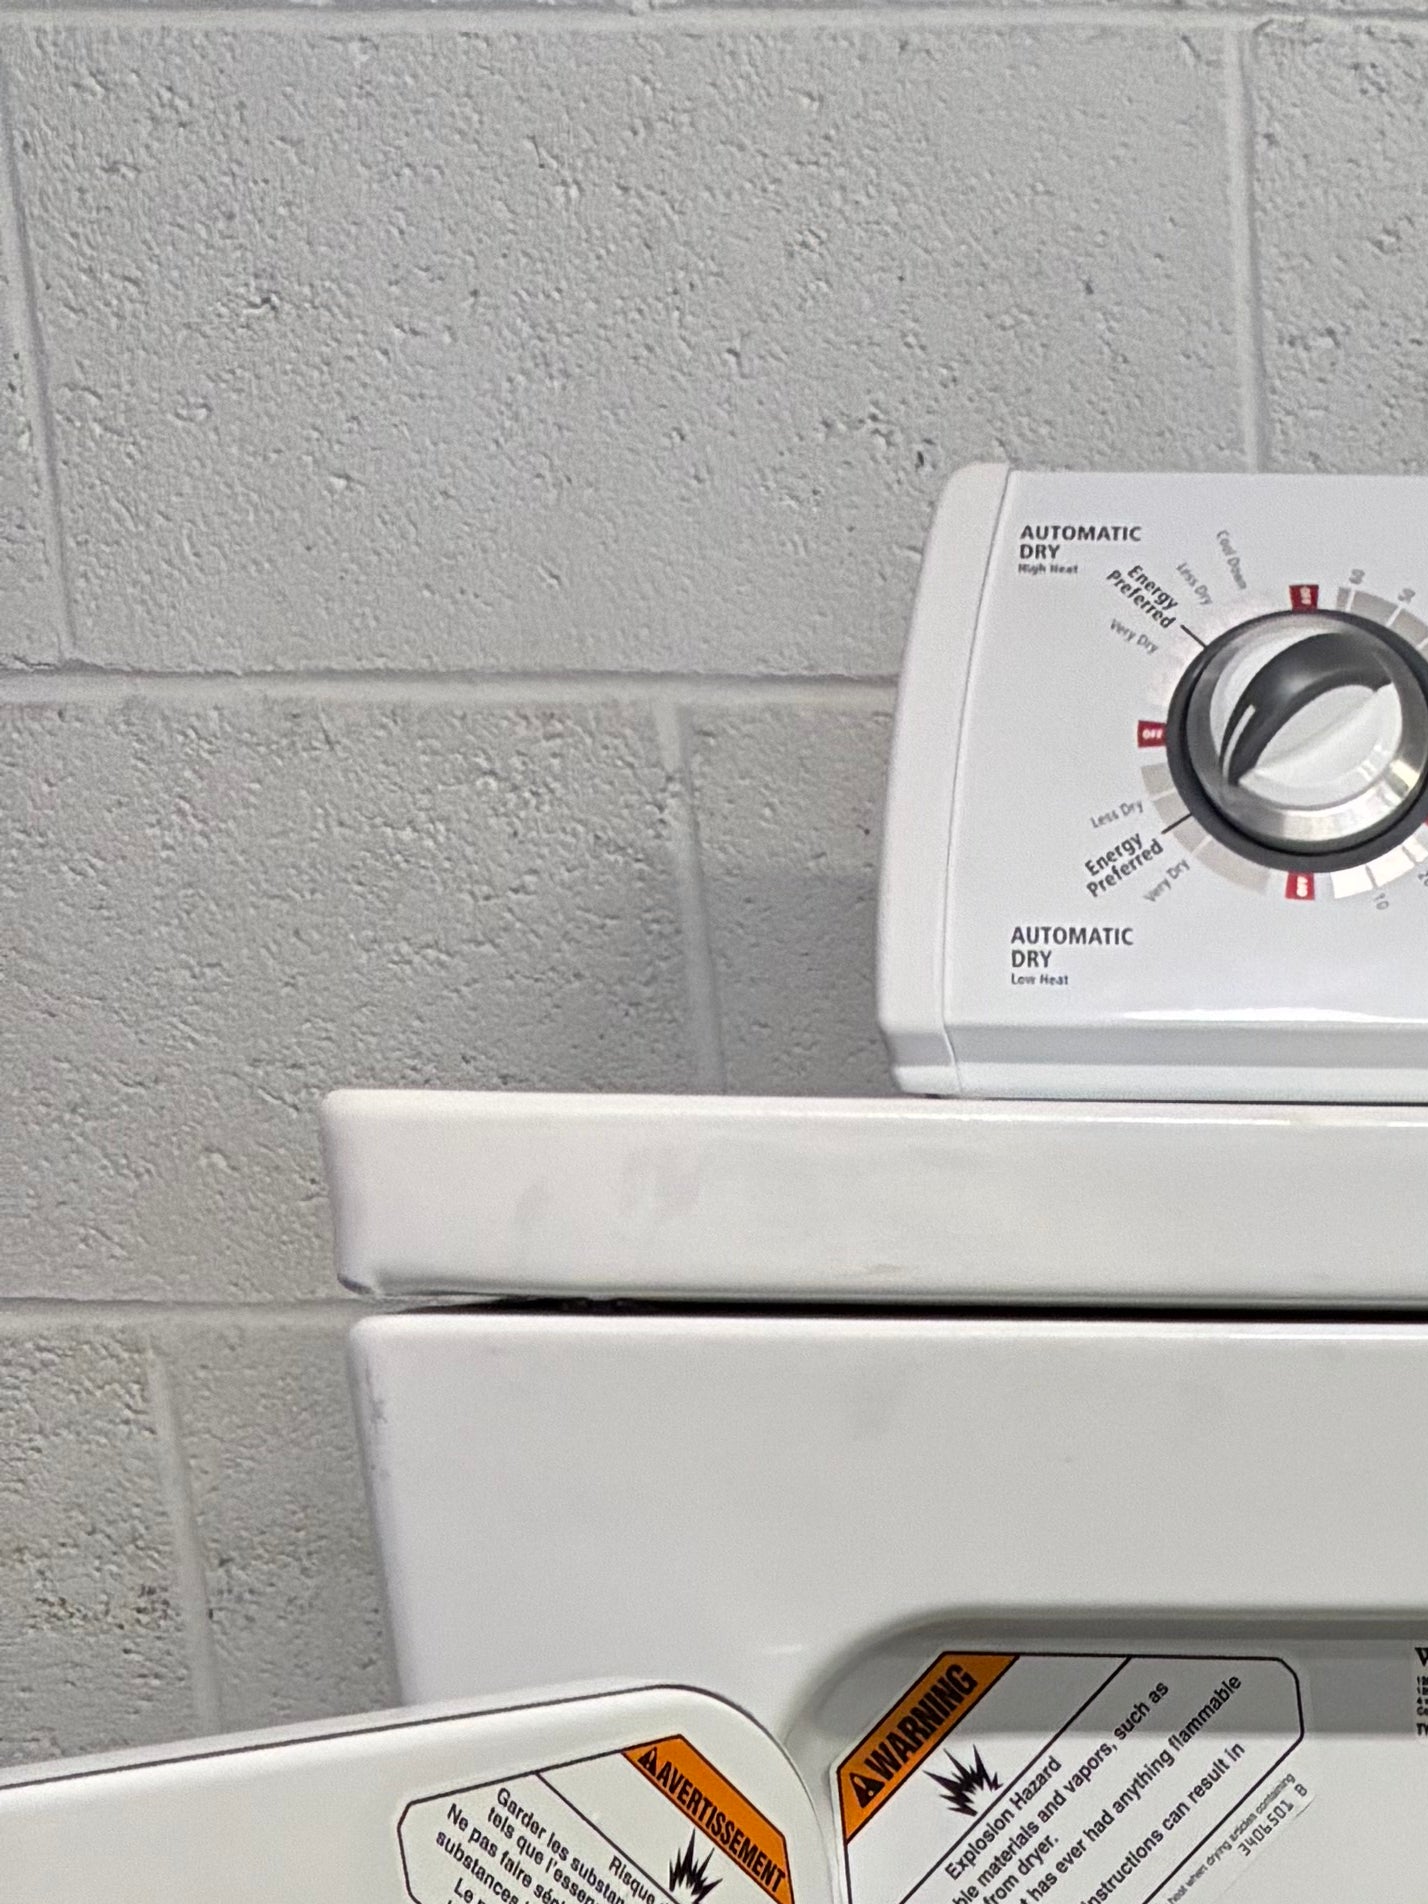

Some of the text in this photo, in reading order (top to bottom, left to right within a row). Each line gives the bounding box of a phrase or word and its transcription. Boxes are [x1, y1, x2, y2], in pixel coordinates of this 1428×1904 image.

[1019, 543, 1061, 560] DRY
[1020, 525, 1142, 542] AUTOMATIC
[1018, 564, 1078, 576] High Heat
[1127, 564, 1178, 610] Energy
[1175, 562, 1213, 606] Less Dry
[1106, 569, 1177, 629] Preferred
[1110, 618, 1159, 655] Very Dry
[1142, 728, 1163, 740] OFF
[1090, 799, 1145, 829] Less Dry
[1084, 832, 1143, 877] Energy
[1086, 838, 1164, 898] Preferred
[1143, 857, 1191, 902] Very Dry
[1374, 893, 1390, 911] 10
[1010, 926, 1134, 946] AUTOMATIC
[1011, 949, 1052, 968] DRY
[1011, 973, 1069, 985] Low Heat
[868, 1664, 978, 1782] WARNING
[977, 1821, 1040, 1887] materials
[1037, 1789, 1067, 1824] and
[1062, 1743, 1118, 1793] vapors,
[1108, 1701, 1151, 1741] such
[1148, 1682, 1169, 1704] as
[1026, 1872, 1058, 1902] has
[1055, 1838, 1087, 1874] ever
[1082, 1808, 1116, 1842] had
[1112, 1749, 1176, 1814] anything
[1167, 1676, 1242, 1752] flammable
[1161, 1802, 1191, 1831] can
[1187, 1758, 1231, 1804] result
[1224, 1743, 1245, 1762] in
[497, 1787, 547, 1840] Garder
[546, 1831, 570, 1864] les
[656, 1762, 787, 1893] AVERTISSEMENT
[944, 1755, 1062, 1881] Explosion Hazard
[1237, 1799, 1295, 1857] 3406501
[1017, 1834, 1059, 1876] dryer.
